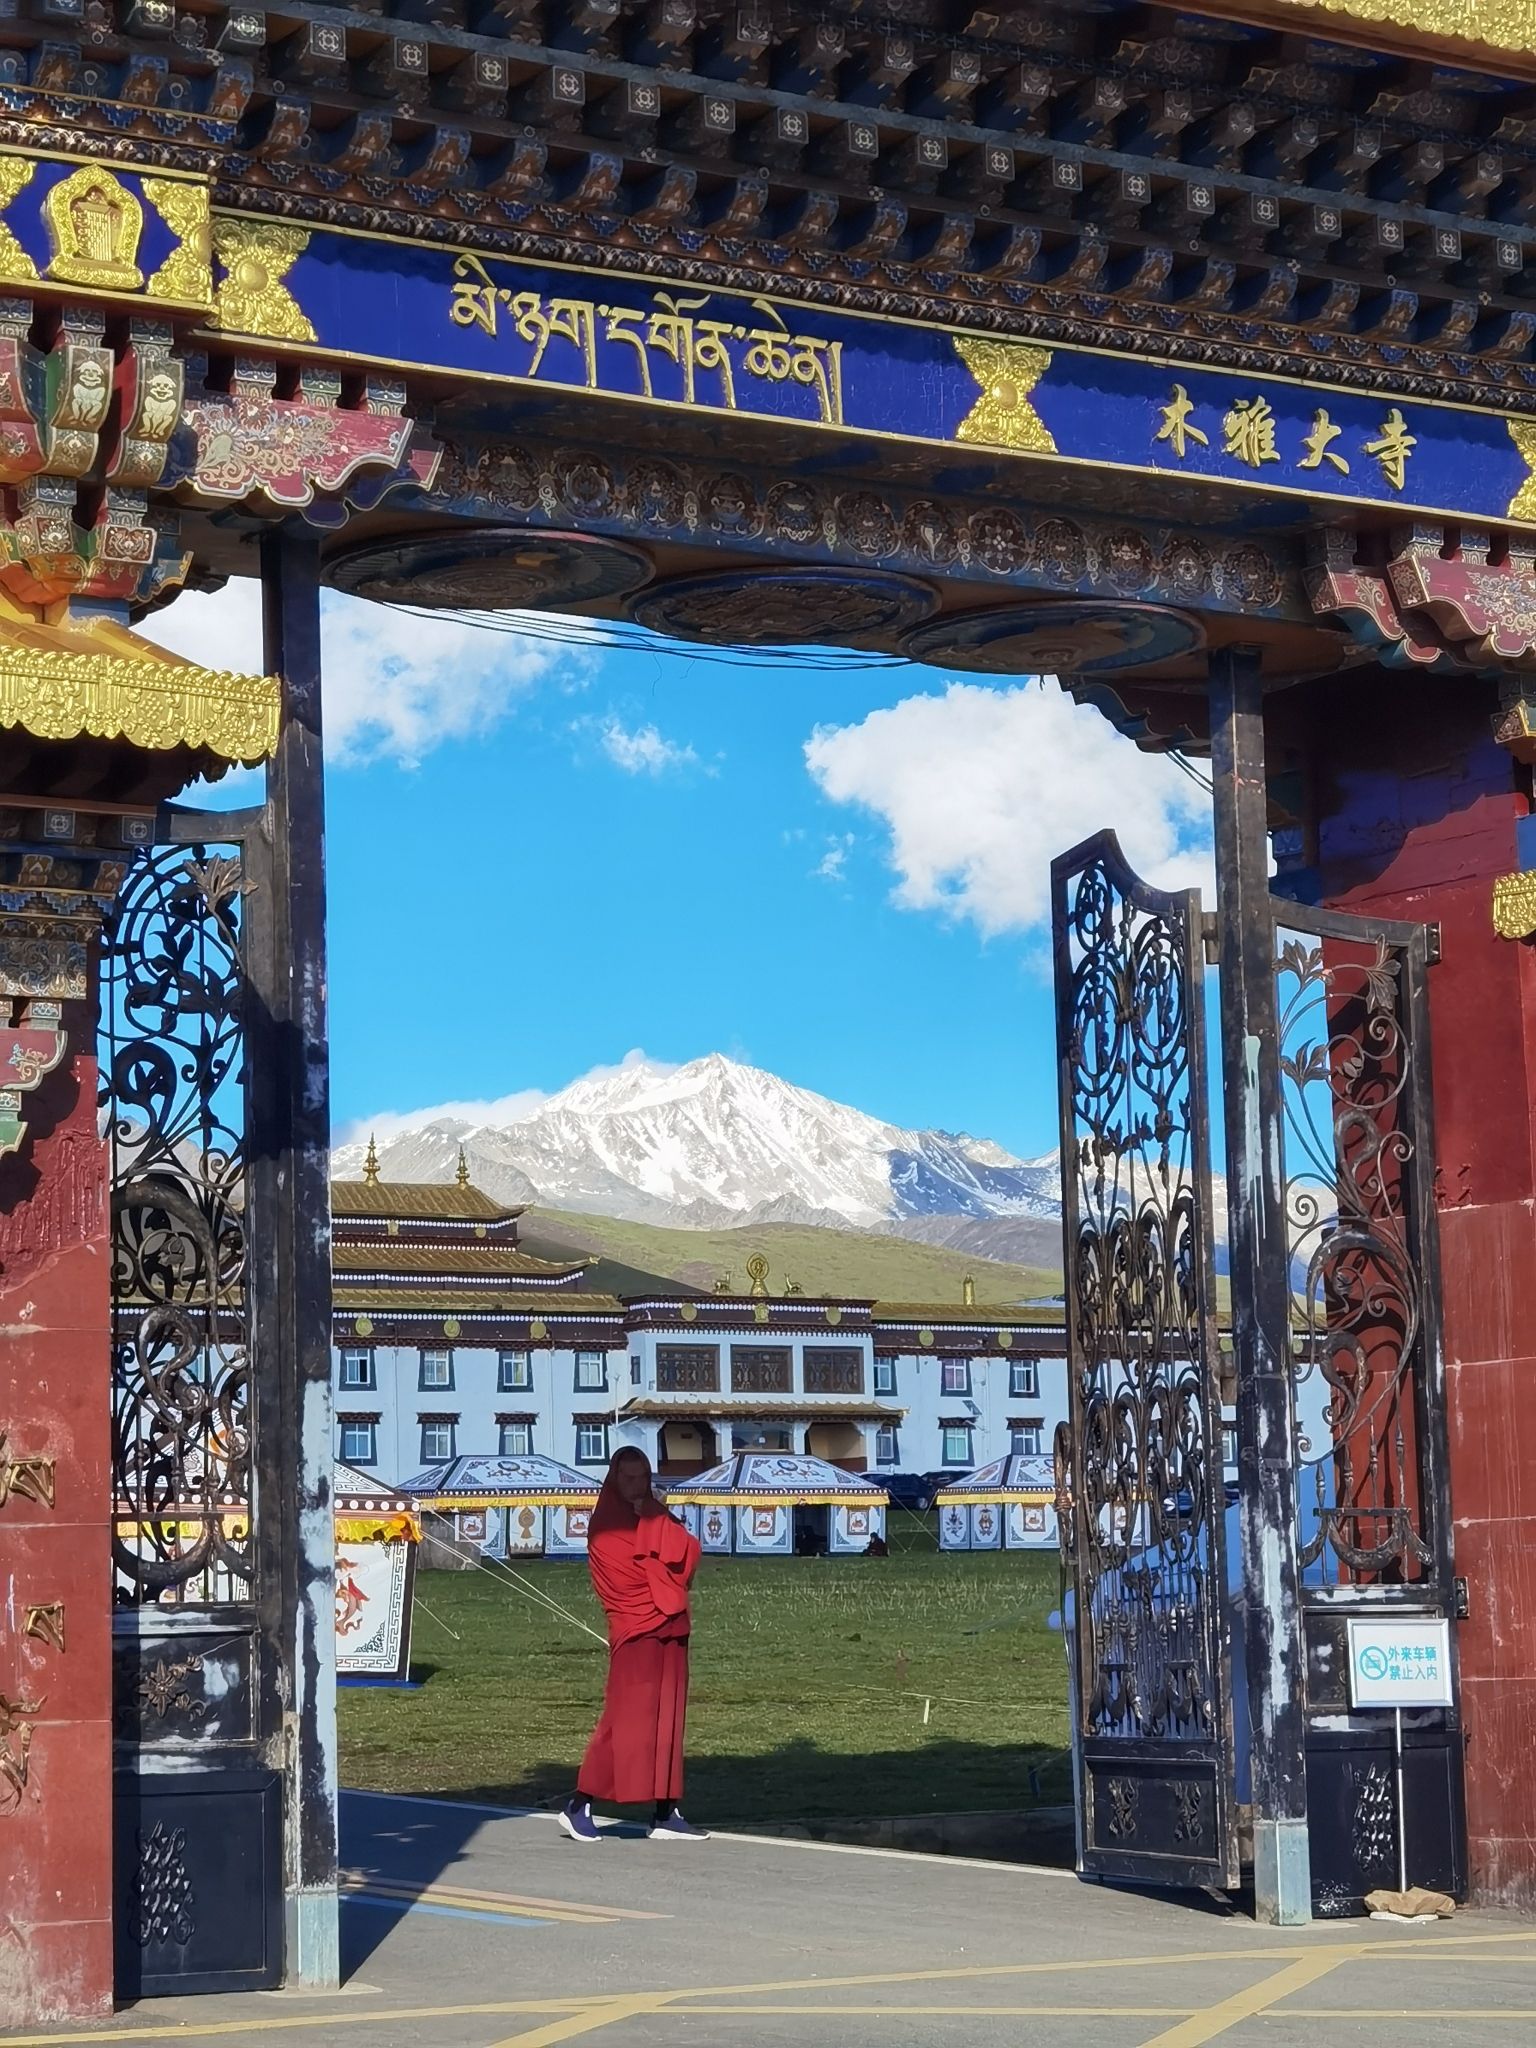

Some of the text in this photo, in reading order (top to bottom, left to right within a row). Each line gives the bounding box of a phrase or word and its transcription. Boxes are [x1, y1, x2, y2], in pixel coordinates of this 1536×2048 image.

[1156, 383, 1417, 490] 木雅大寺
[1388, 1646, 1437, 1661] 外来车辆
[1389, 1665, 1438, 1681] 禁止入内
